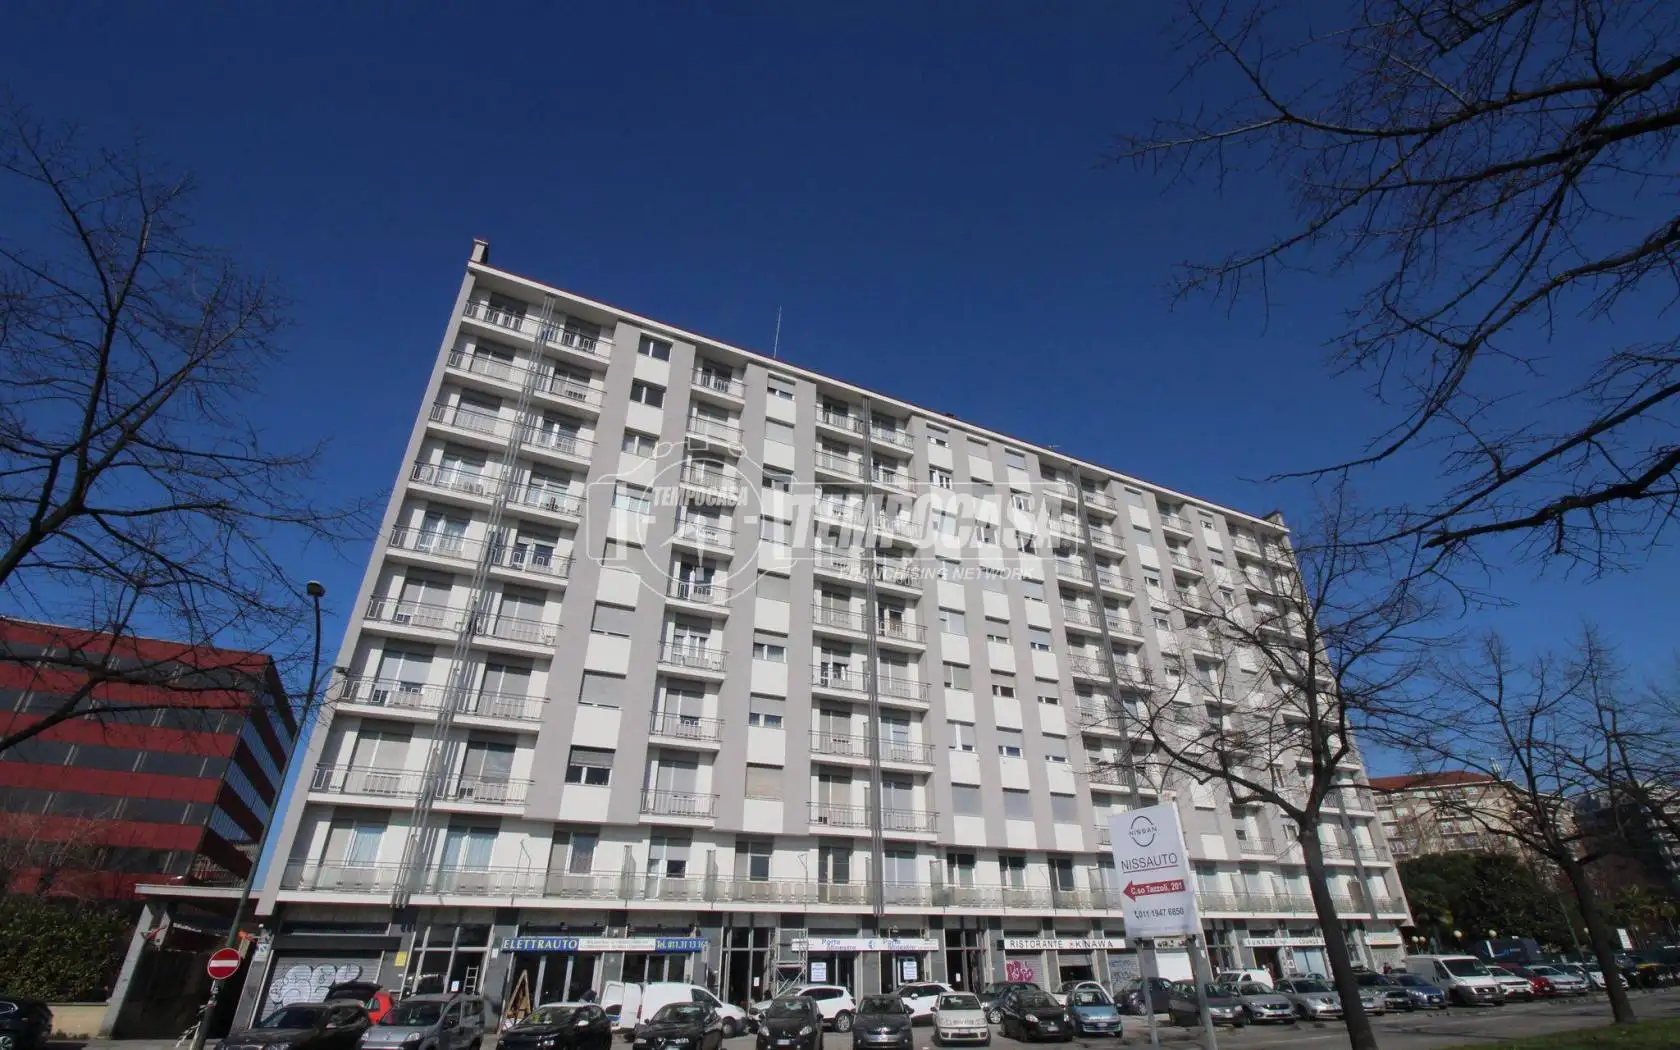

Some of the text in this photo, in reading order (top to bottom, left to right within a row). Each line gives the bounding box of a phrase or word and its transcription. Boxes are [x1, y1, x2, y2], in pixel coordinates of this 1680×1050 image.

[1128, 826, 1157, 837] NISSAN
[1121, 852, 1178, 871] NISSAUTO
[1171, 881, 1182, 891] 201
[1138, 909, 1149, 918] 011
[1151, 908, 1166, 917] 1947
[503, 938, 578, 949] ELETTRAUTO
[1009, 940, 1064, 949] RISTORANTE
